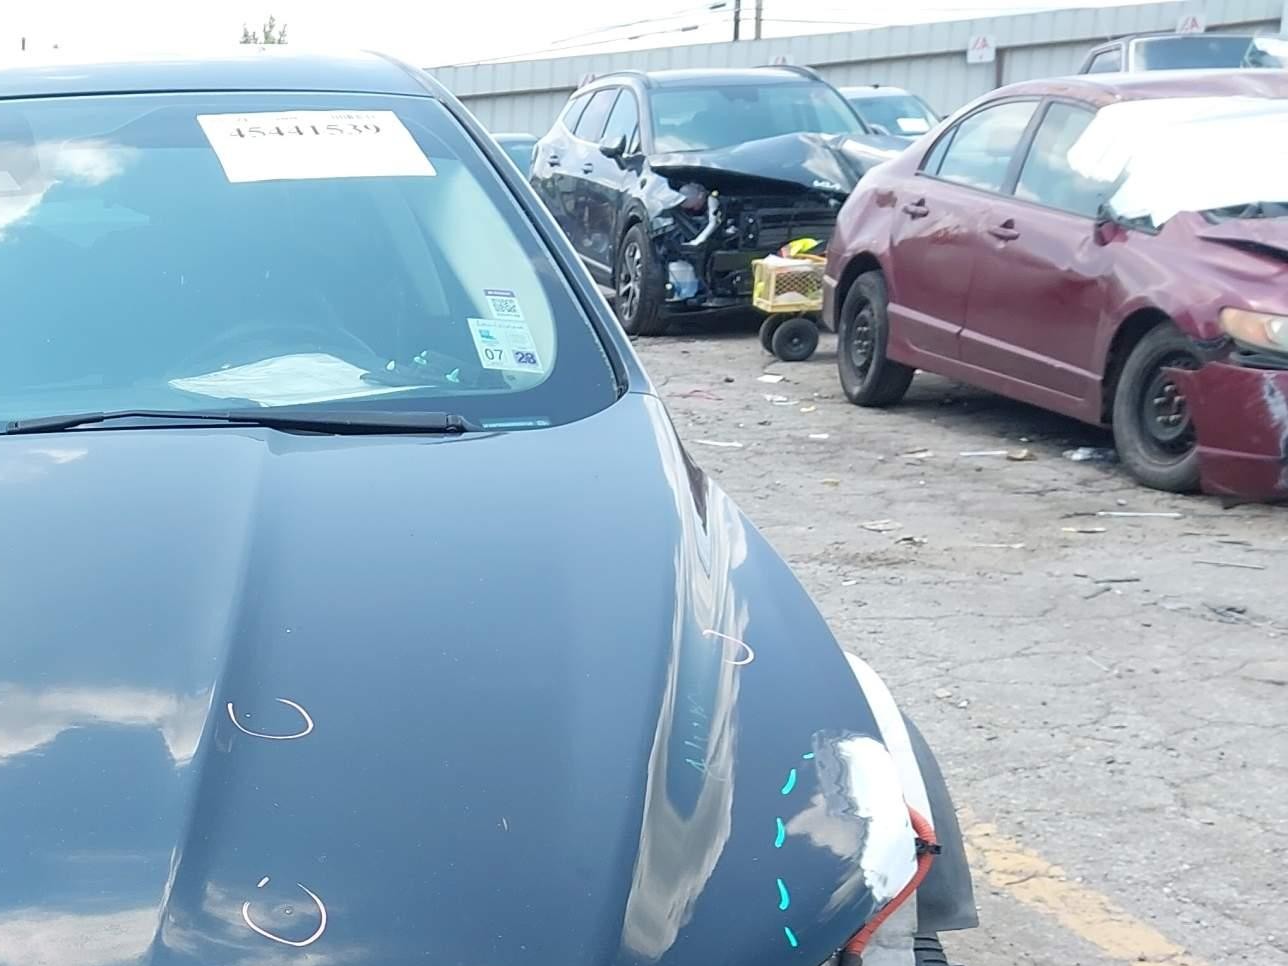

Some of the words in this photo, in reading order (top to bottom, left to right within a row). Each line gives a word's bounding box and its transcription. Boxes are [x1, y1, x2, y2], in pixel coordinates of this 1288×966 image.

[229, 124, 381, 138] 45441539
[484, 347, 503, 361] 07
[515, 351, 537, 364] 28
